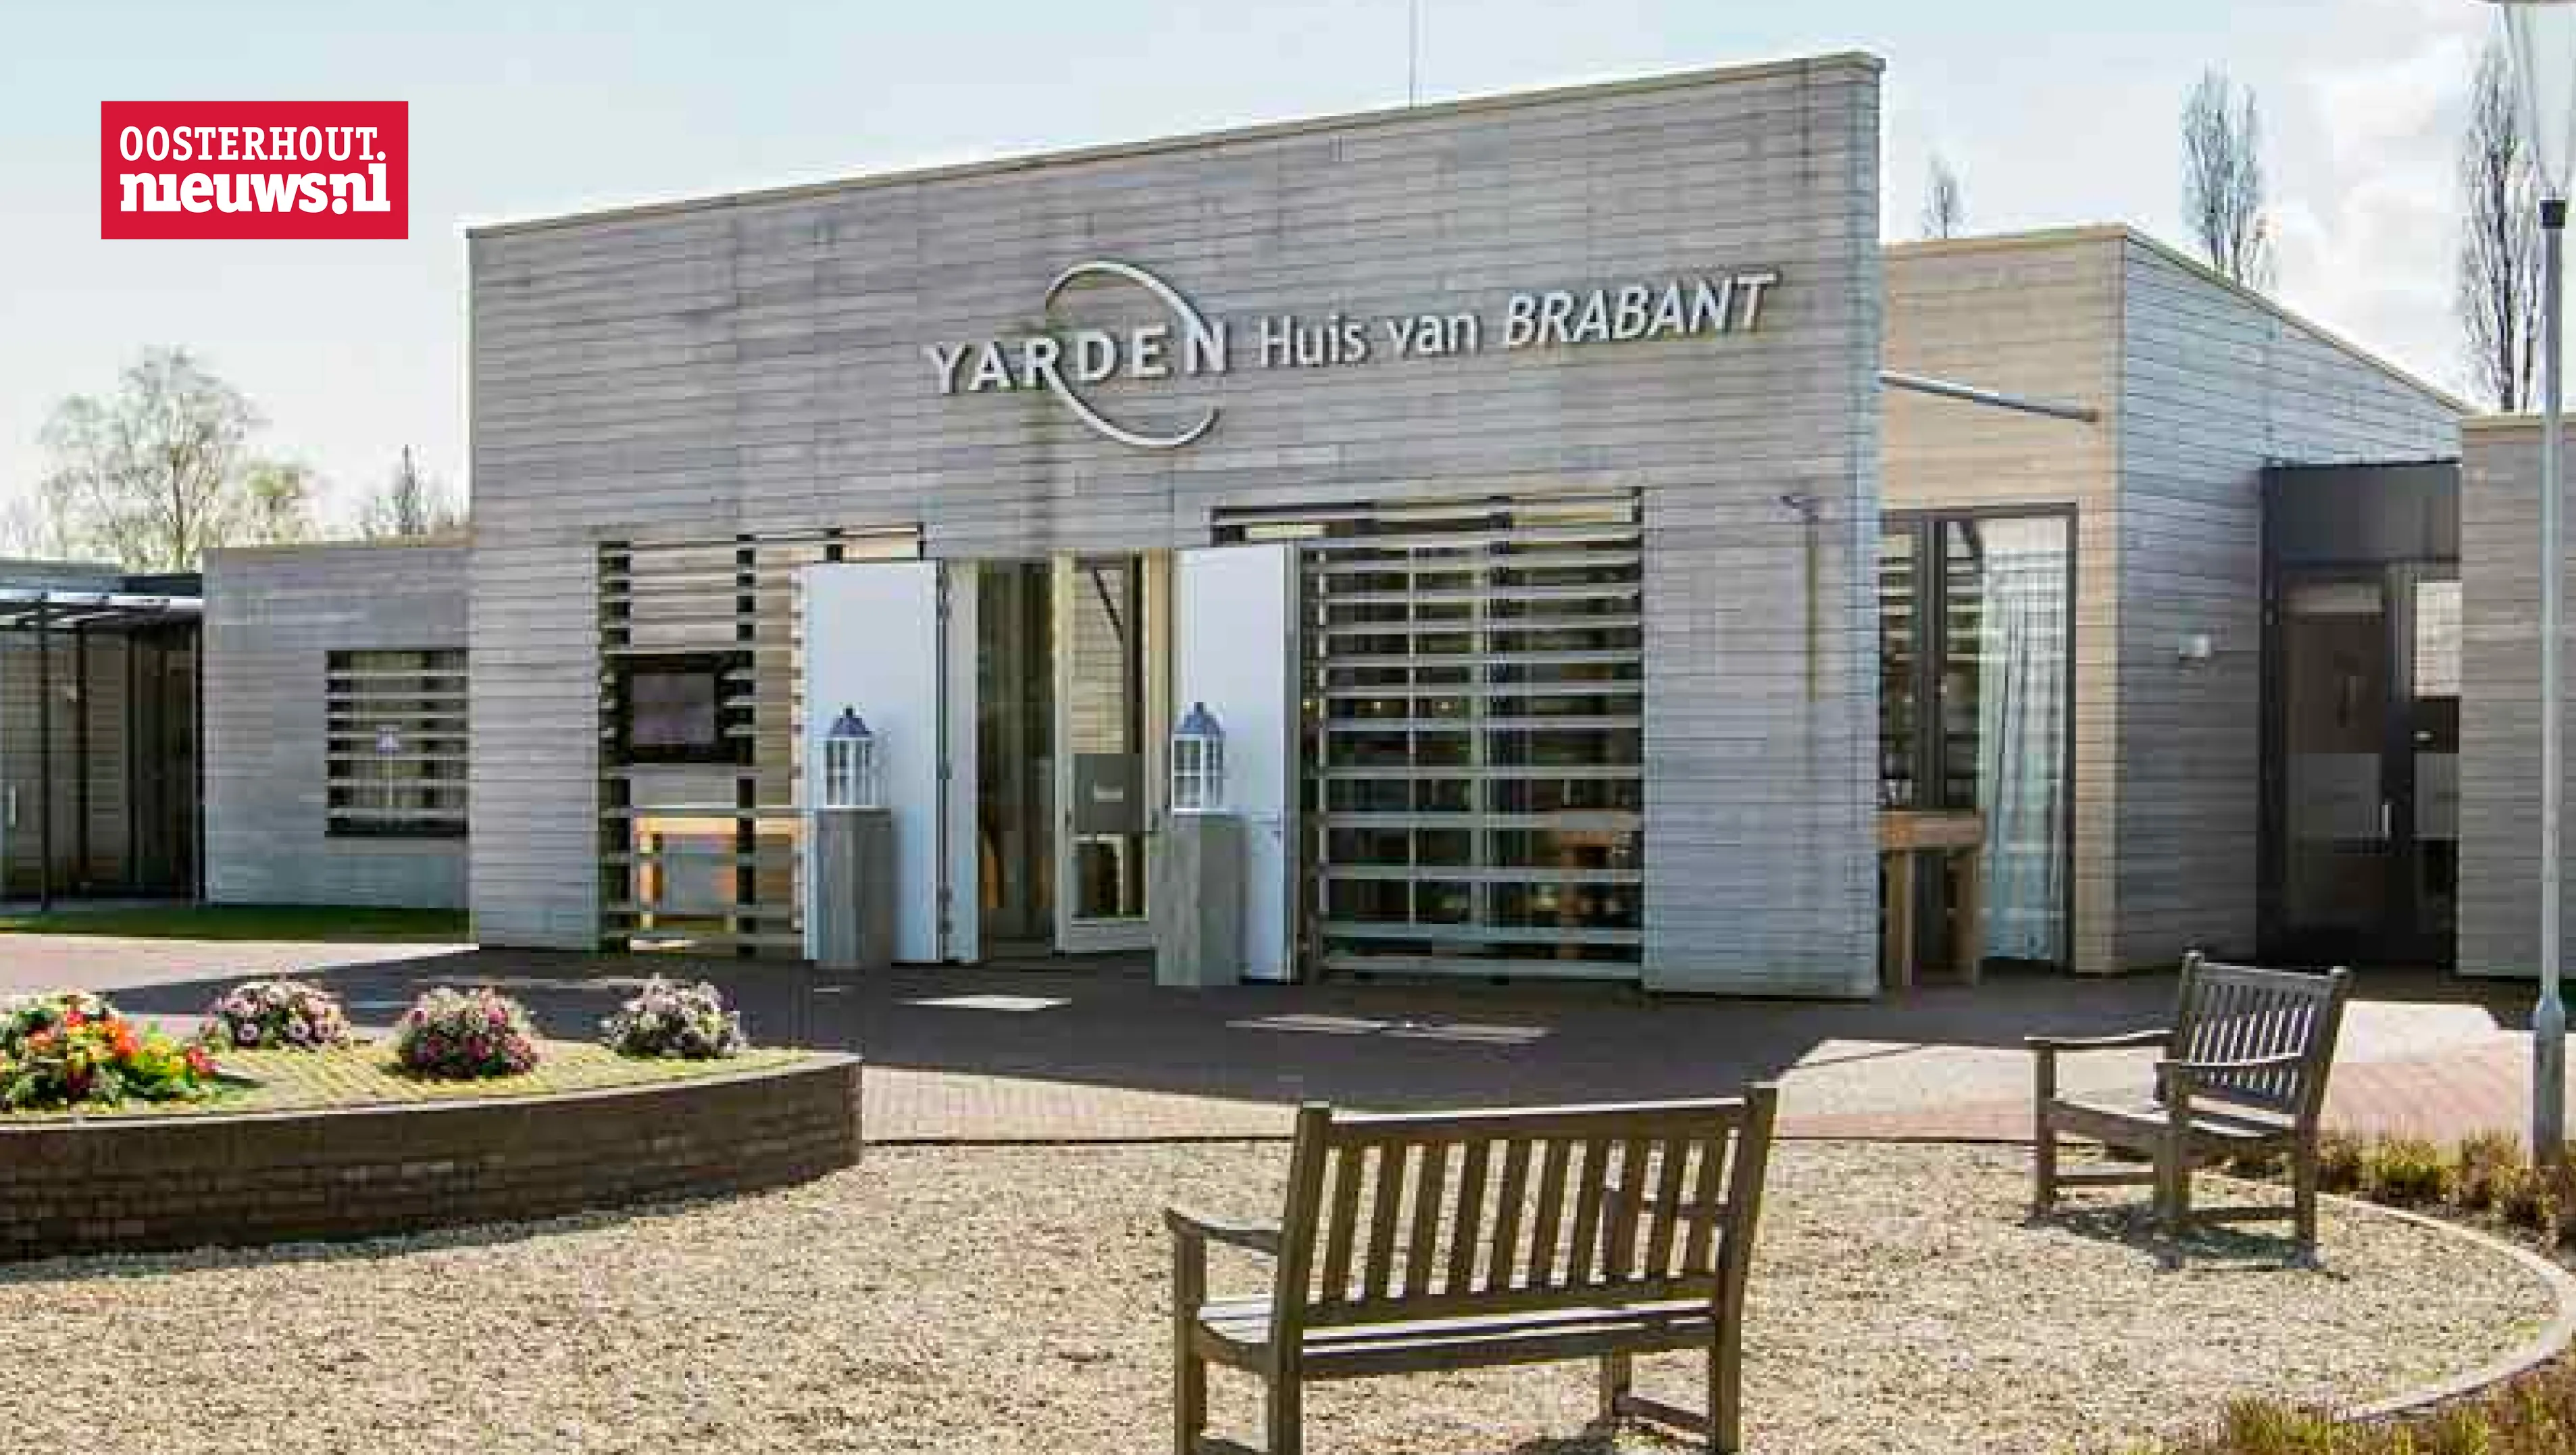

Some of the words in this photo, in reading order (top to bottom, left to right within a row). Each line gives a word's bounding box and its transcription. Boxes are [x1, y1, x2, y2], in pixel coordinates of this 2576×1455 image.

[921, 319, 1228, 394] YARDEN
[1259, 313, 1367, 368] Huis
[1387, 311, 1480, 357] van
[1504, 272, 1778, 347] BRABANT
